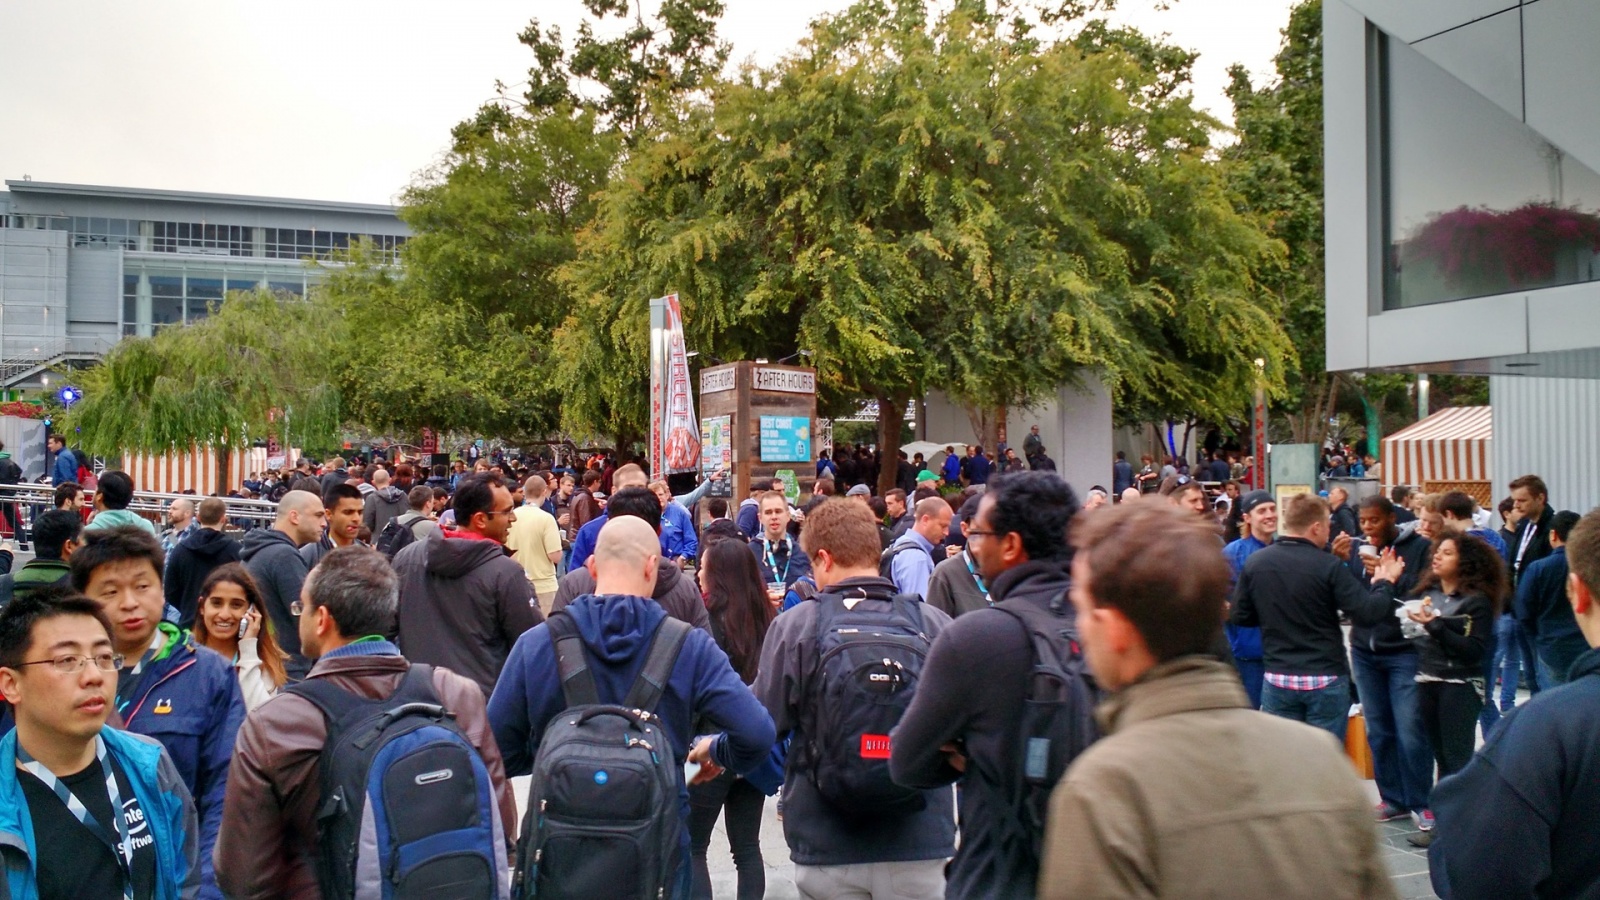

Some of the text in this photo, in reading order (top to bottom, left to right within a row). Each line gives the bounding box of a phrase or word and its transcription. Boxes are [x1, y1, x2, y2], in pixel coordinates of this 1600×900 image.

[672, 333, 688, 420] STREET
[705, 370, 734, 389] AFTER HOURS
[763, 371, 813, 390] AFTER HOURS
[124, 808, 144, 825] nte
[117, 834, 153, 854] Sftwa
